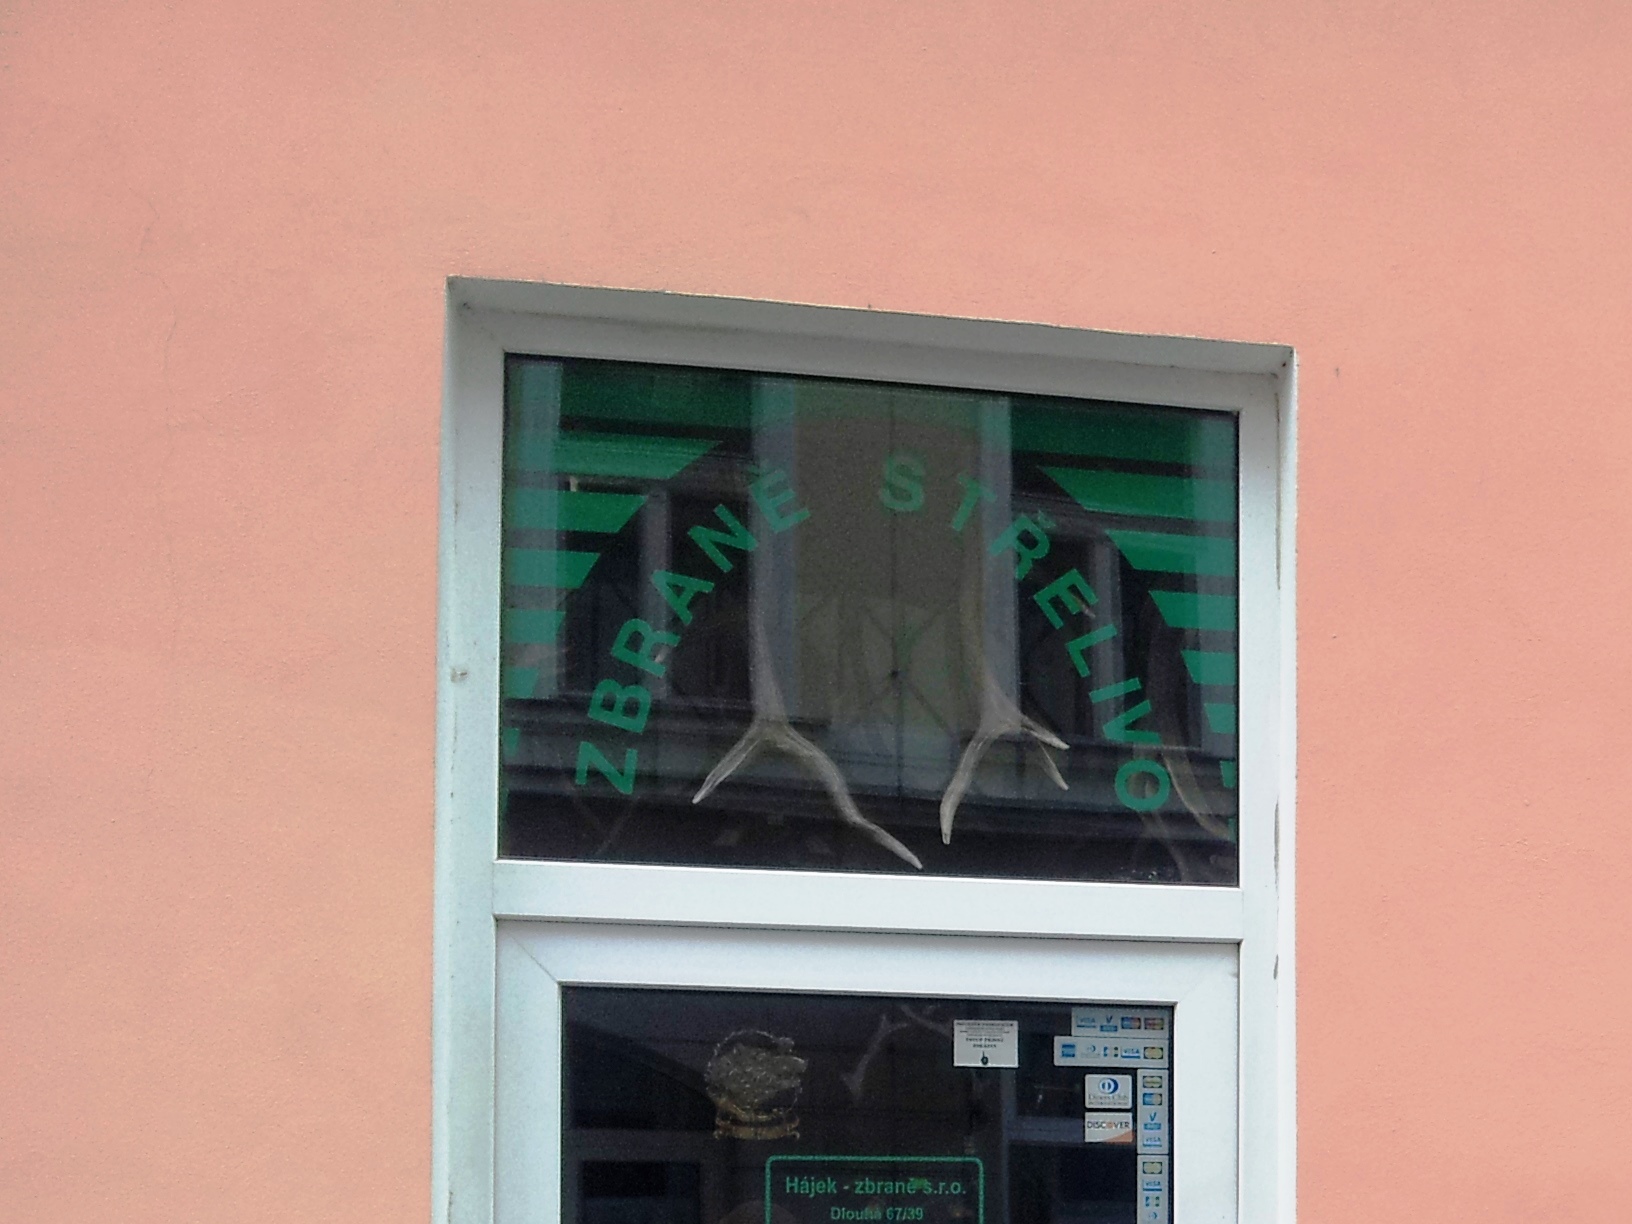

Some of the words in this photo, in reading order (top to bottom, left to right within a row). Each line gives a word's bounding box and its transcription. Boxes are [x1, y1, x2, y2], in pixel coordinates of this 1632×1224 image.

[878, 450, 1170, 812] STŘELIVO
[1087, 1120, 1130, 1129] DISCOVER
[785, 1176, 838, 1198] Hájek
[854, 1178, 917, 1194] zbraně
[922, 1180, 967, 1195] s.r.o.
[886, 1206, 924, 1220] 67/39
